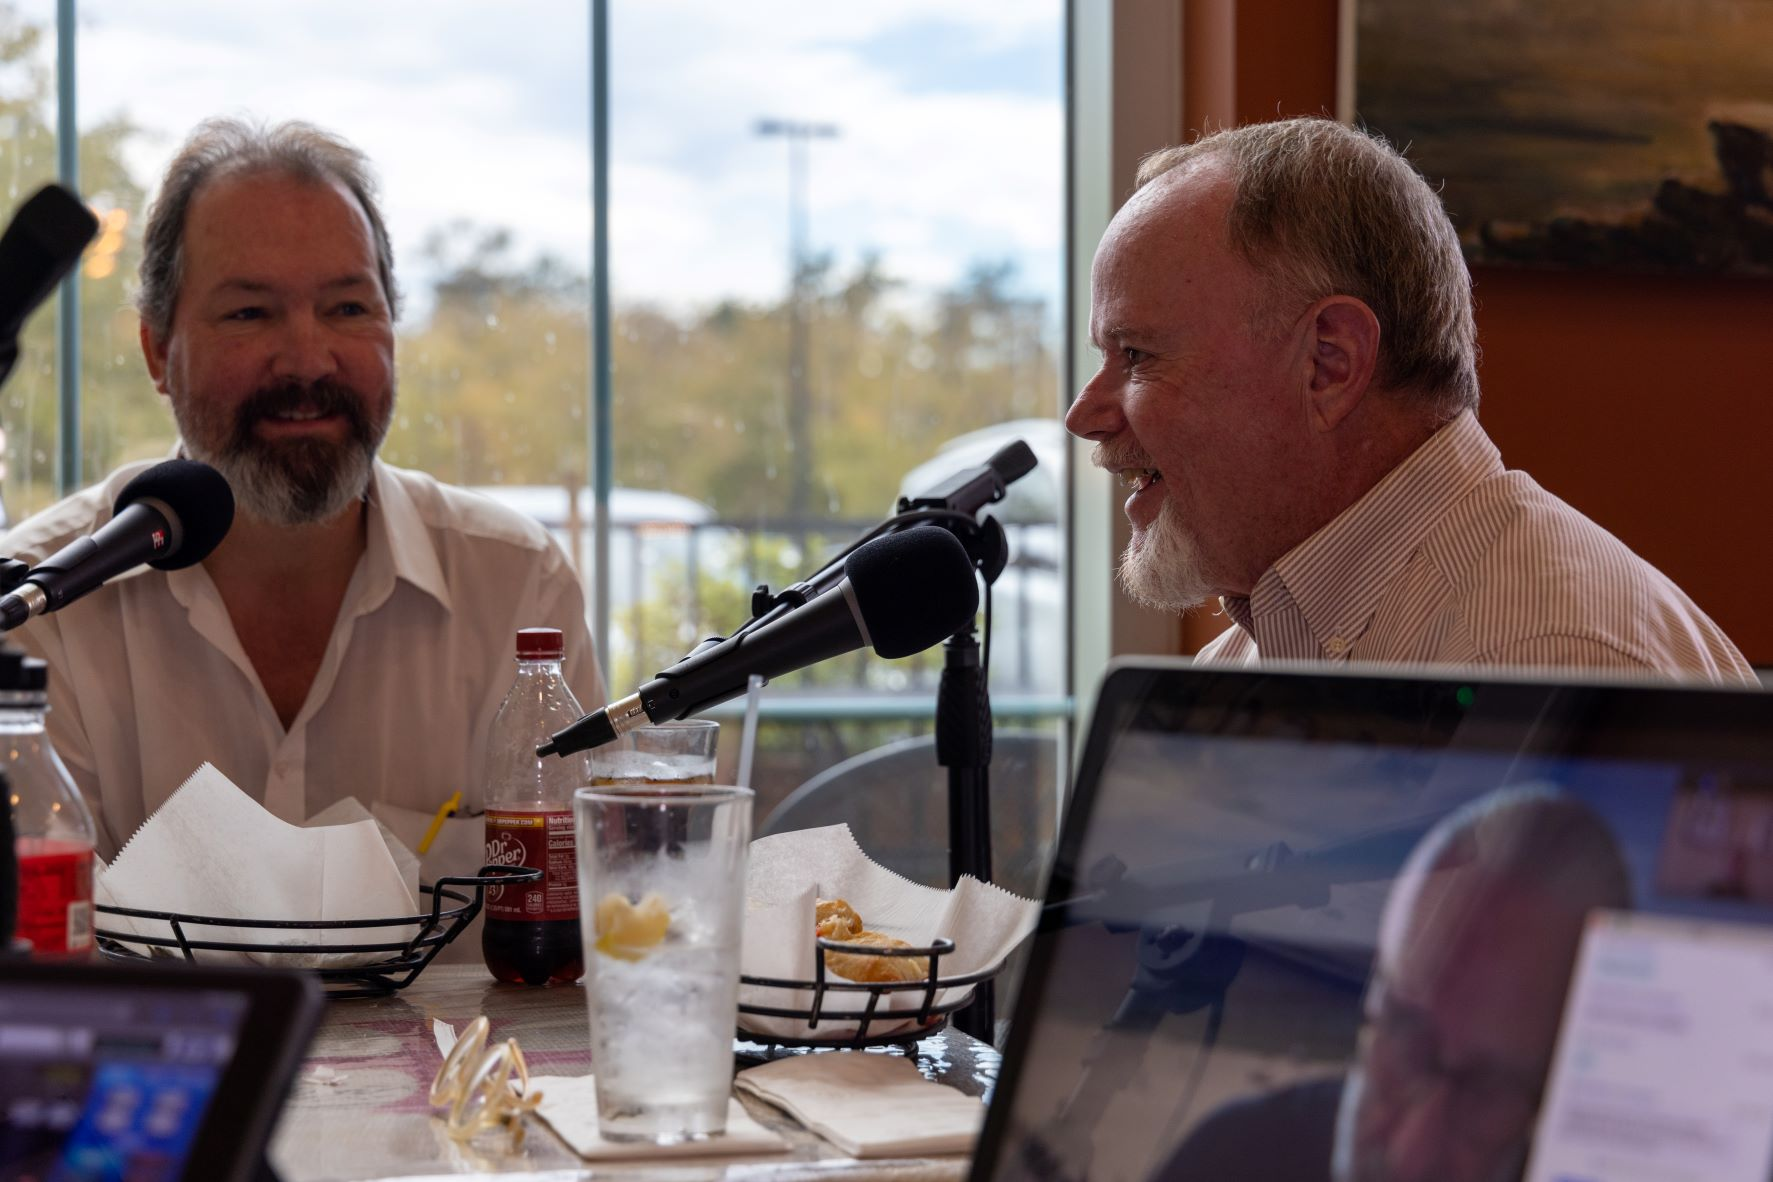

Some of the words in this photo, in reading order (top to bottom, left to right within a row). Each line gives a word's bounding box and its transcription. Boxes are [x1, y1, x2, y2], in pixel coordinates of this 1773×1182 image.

[549, 839, 573, 848] Calories
[491, 839, 508, 858] Dr
[527, 894, 542, 903] 240
